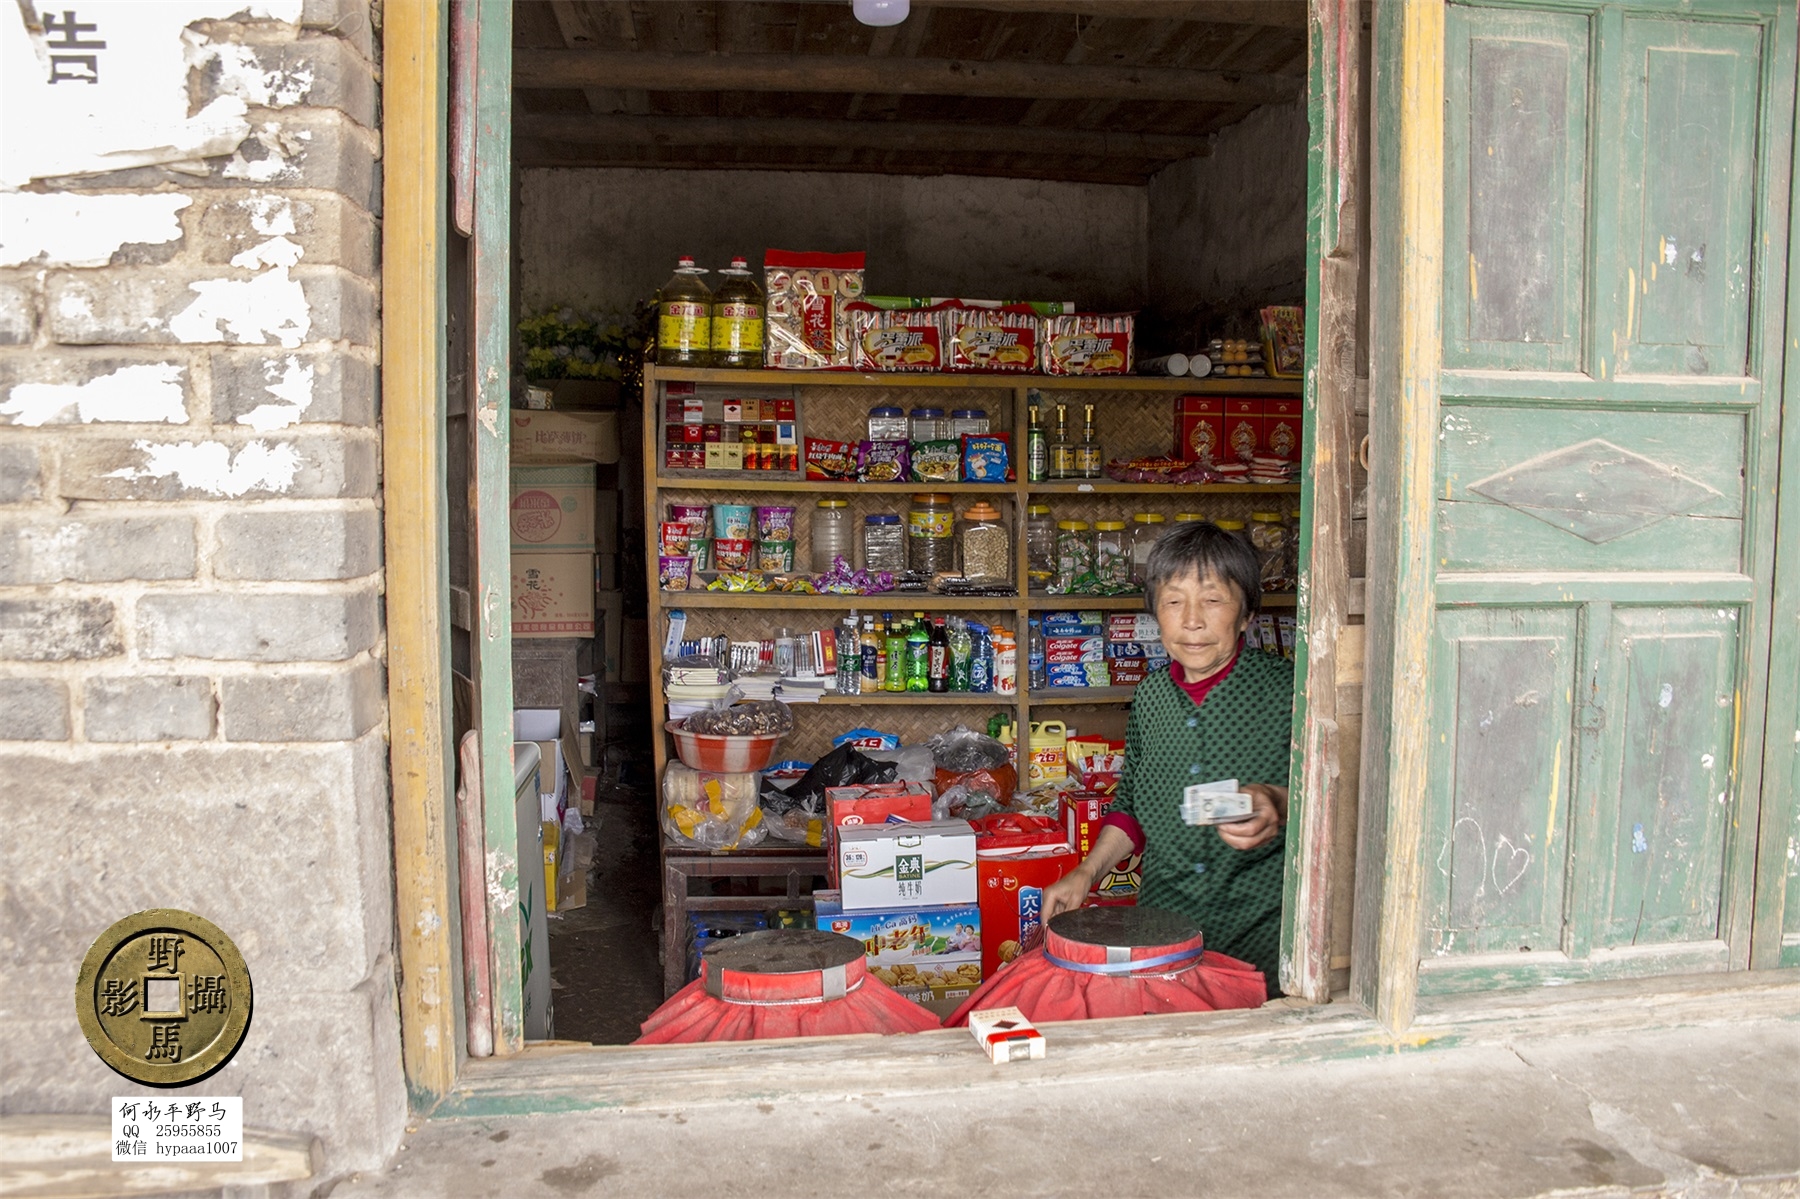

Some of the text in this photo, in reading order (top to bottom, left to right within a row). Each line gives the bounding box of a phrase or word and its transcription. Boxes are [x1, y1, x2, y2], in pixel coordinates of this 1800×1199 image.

[43, 11, 107, 84] 告
[526, 568, 541, 590] 雪花
[1049, 643, 1078, 652] Colgate
[1049, 655, 1078, 663] Colgate
[898, 857, 921, 874] 金典
[899, 881, 923, 897] 纯牛奶
[871, 914, 918, 933] Hi-Ca 高钙
[865, 924, 931, 956] 中老年
